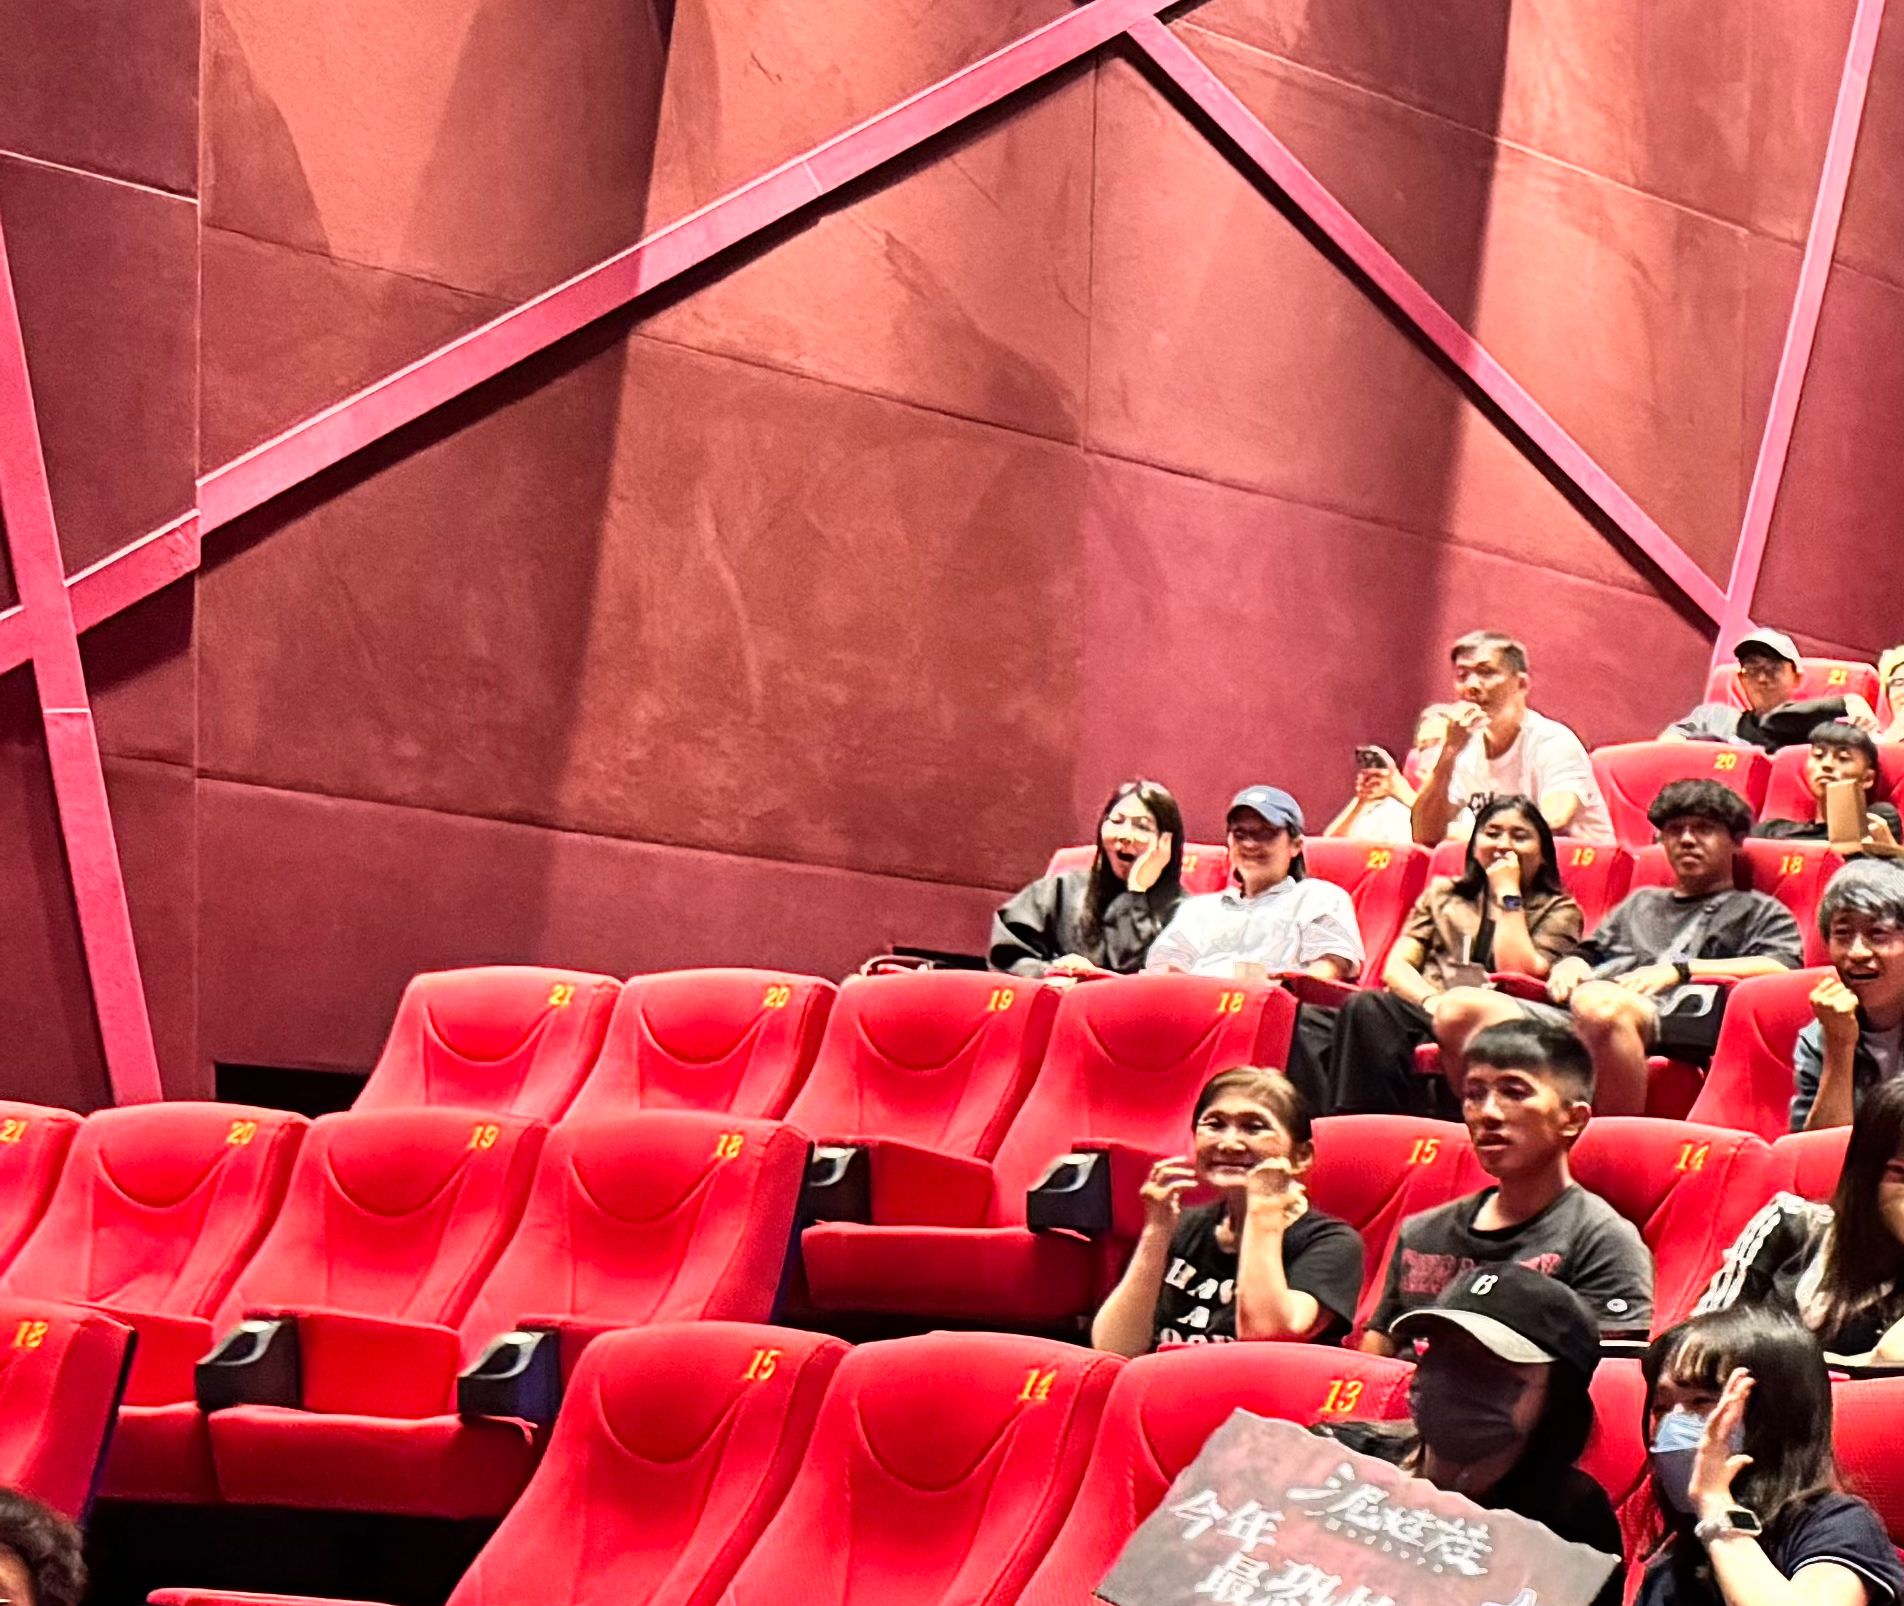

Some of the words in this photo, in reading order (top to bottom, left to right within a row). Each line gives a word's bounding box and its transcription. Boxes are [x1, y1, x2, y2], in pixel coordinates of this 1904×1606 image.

[1829, 664, 1848, 685] 21
[1717, 753, 1737, 769] 20
[1368, 848, 1391, 868] 20
[1574, 848, 1595, 865] 19
[1782, 856, 1803, 874] 18
[550, 985, 573, 1007] 21
[765, 987, 789, 1008] 20
[989, 990, 1014, 1010] 19
[1219, 993, 1244, 1012] 18
[0, 1120, 26, 1142] 21
[229, 1122, 256, 1144] 20
[471, 1126, 498, 1148] 19
[717, 1135, 742, 1157] 18
[1410, 1139, 1439, 1164] 15
[1677, 1145, 1708, 1170] 14
[16, 1322, 47, 1348] 18
[745, 1350, 780, 1380] 15
[1022, 1372, 1054, 1399] 14
[1323, 1382, 1362, 1413] 13
[1170, 1488, 1286, 1554] 今年
[1286, 1462, 1494, 1576] 泥娃娃
